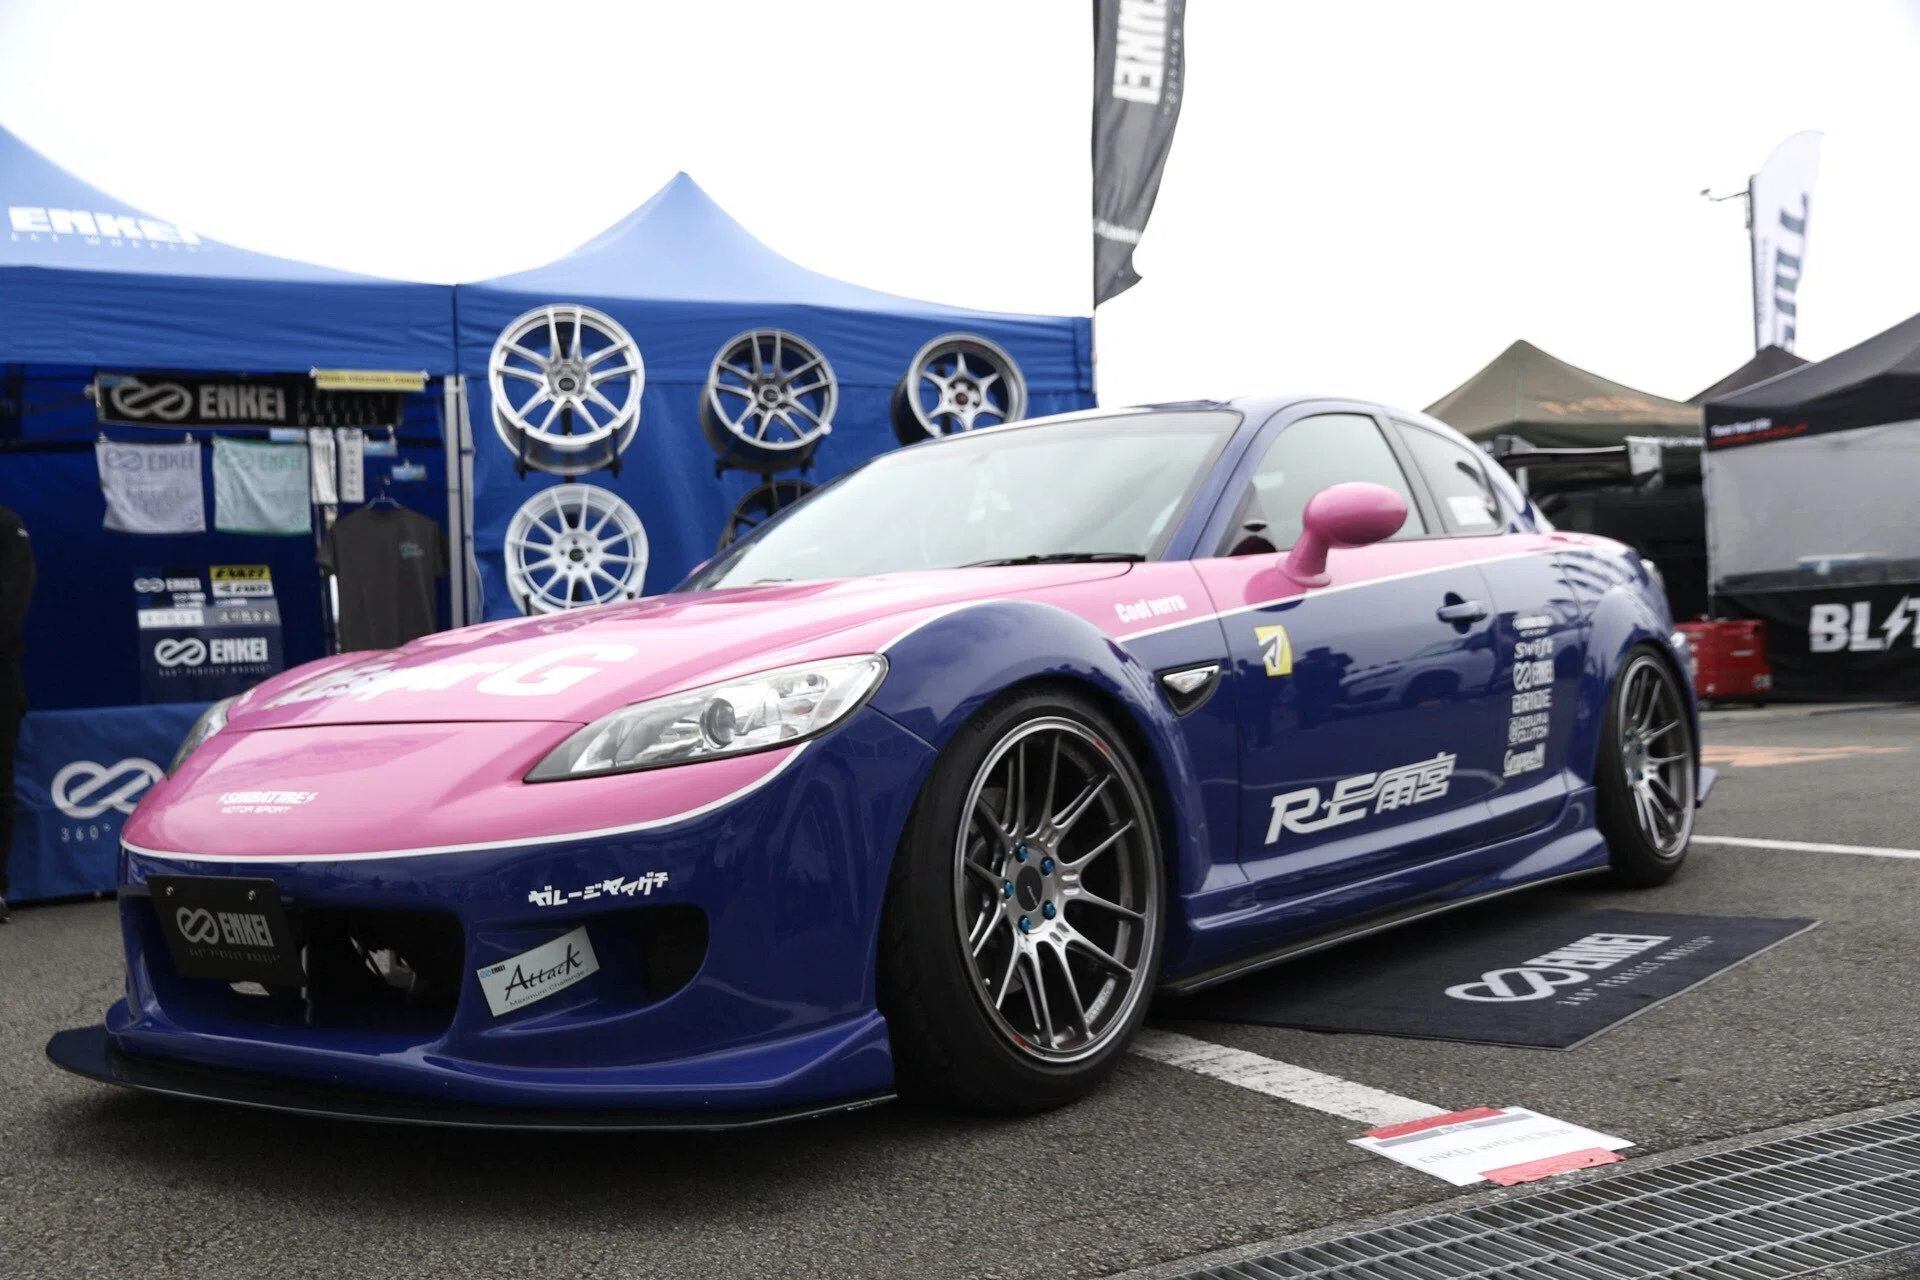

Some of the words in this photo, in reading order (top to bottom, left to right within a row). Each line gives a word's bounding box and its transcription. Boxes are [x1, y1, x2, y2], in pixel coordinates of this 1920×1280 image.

[8, 206, 201, 246] ENKEI
[200, 384, 287, 420] ENKEI
[209, 637, 268, 664] ENKEI
[1511, 688, 1553, 715] BRIDE
[528, 871, 669, 907] ガレージヤマグチ
[217, 912, 275, 947] ENKEI
[1521, 932, 1673, 970] ENKEI
[505, 943, 584, 1002] Attack
[509, 988, 549, 1007] Maximum
[1416, 1147, 1477, 1165] ENKEI
